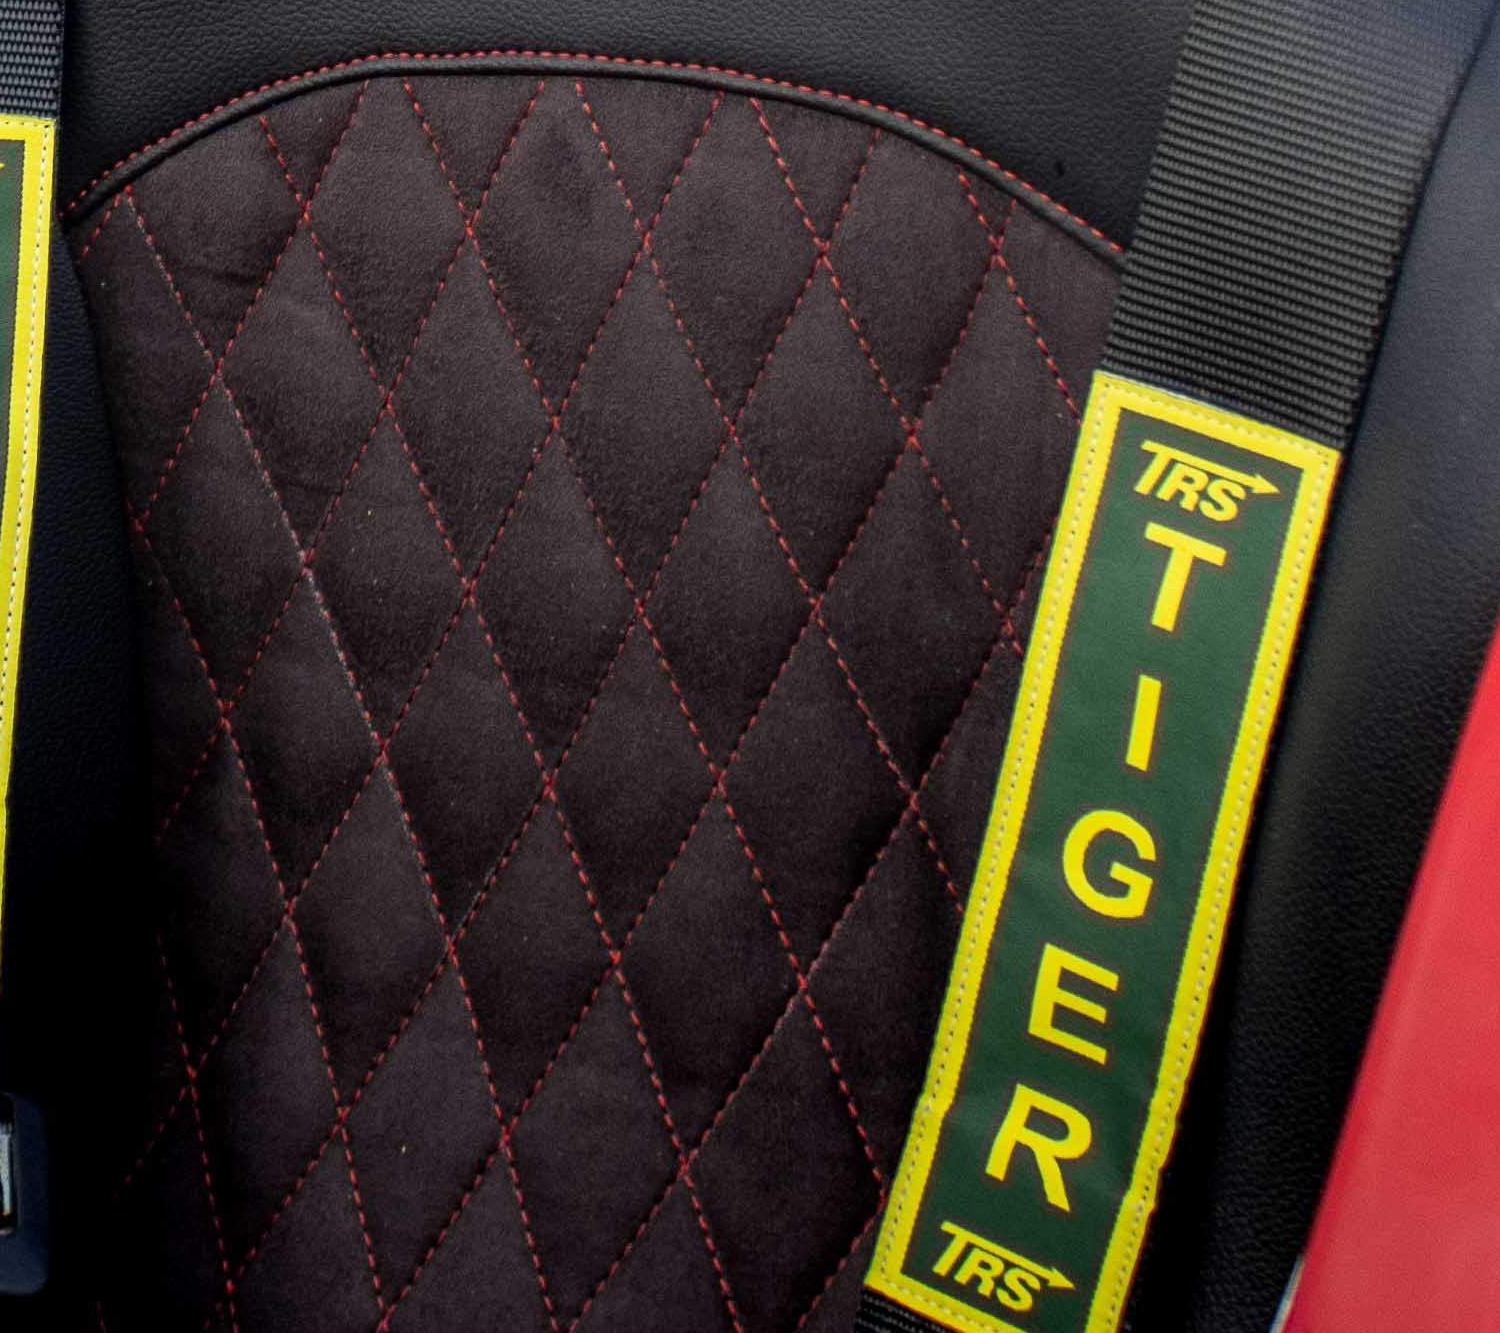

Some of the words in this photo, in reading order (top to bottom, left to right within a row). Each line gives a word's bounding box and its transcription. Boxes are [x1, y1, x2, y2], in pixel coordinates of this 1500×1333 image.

[1134, 439, 1280, 523] TRS
[985, 521, 1229, 1212] TIGER
[931, 1220, 1076, 1312] TRS
